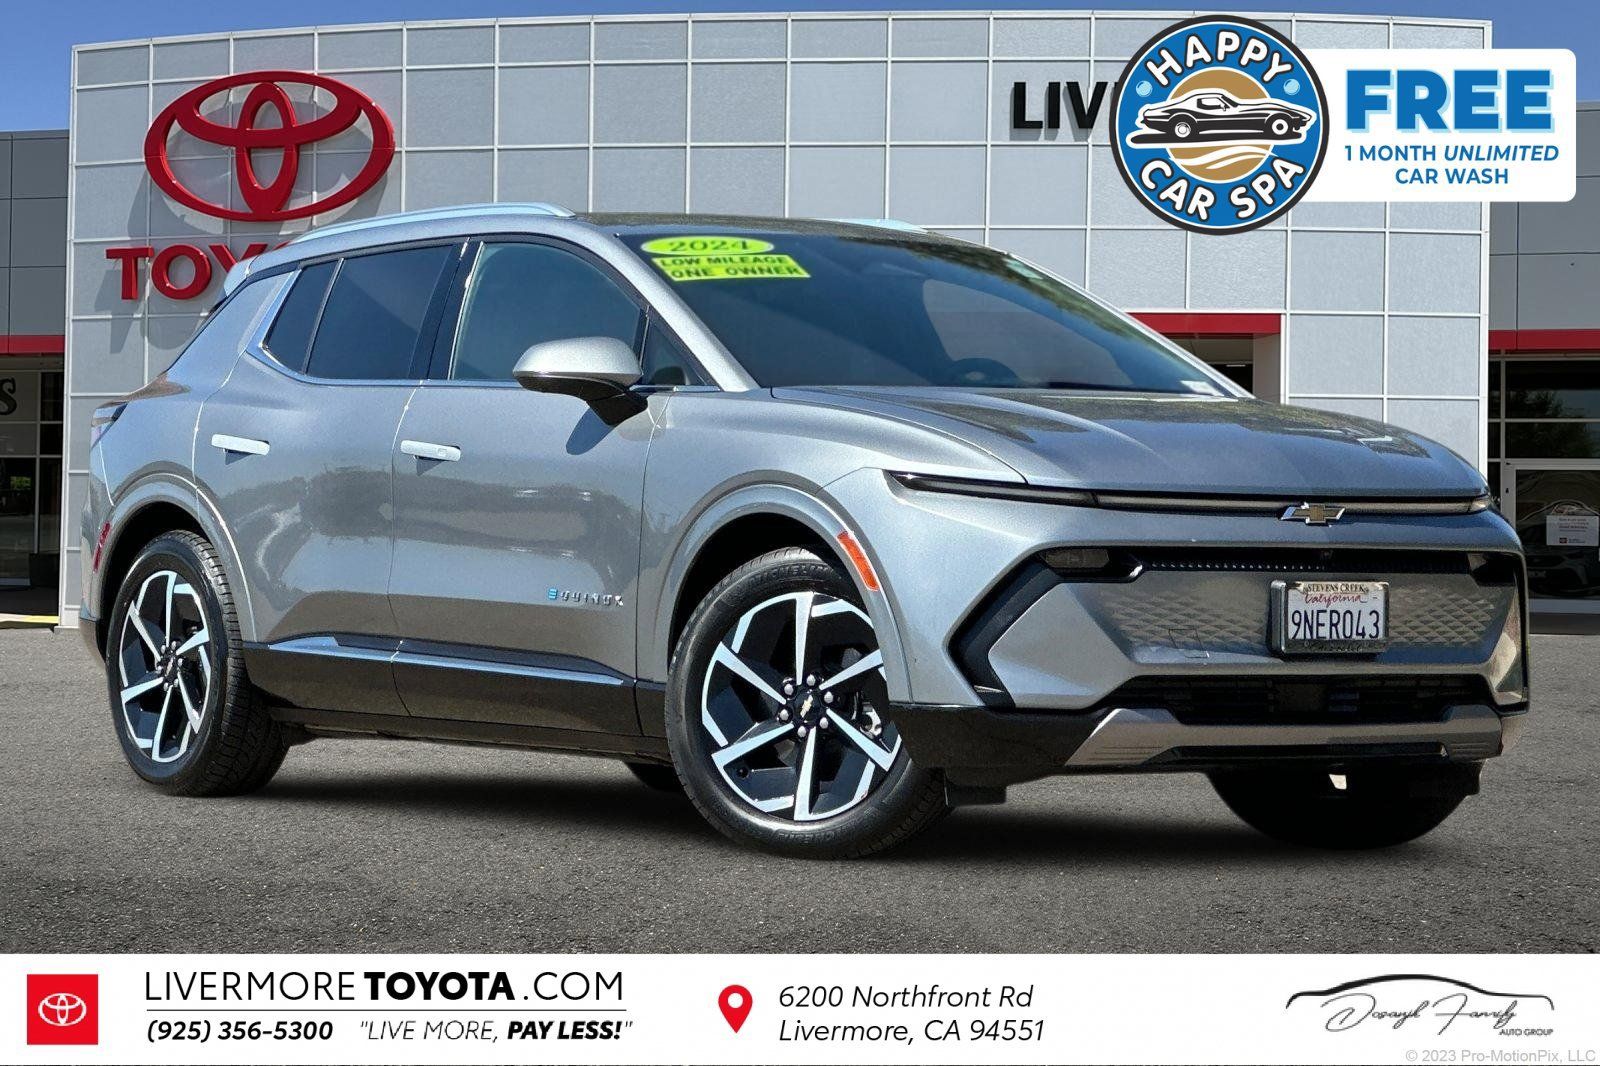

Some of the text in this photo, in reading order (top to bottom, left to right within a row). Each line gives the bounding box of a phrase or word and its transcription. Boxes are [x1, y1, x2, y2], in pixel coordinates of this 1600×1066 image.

[1012, 81, 1119, 130] LIV
[668, 239, 750, 252] 2024
[659, 256, 787, 267] LOW MILEAGE
[106, 241, 291, 300] TOY
[670, 266, 801, 278] ONE OWNER
[1307, 583, 1365, 592] STEVENS CREEK
[547, 587, 624, 607] EQUINOX
[1304, 593, 1368, 608] California
[1291, 610, 1380, 640] 9NER043
